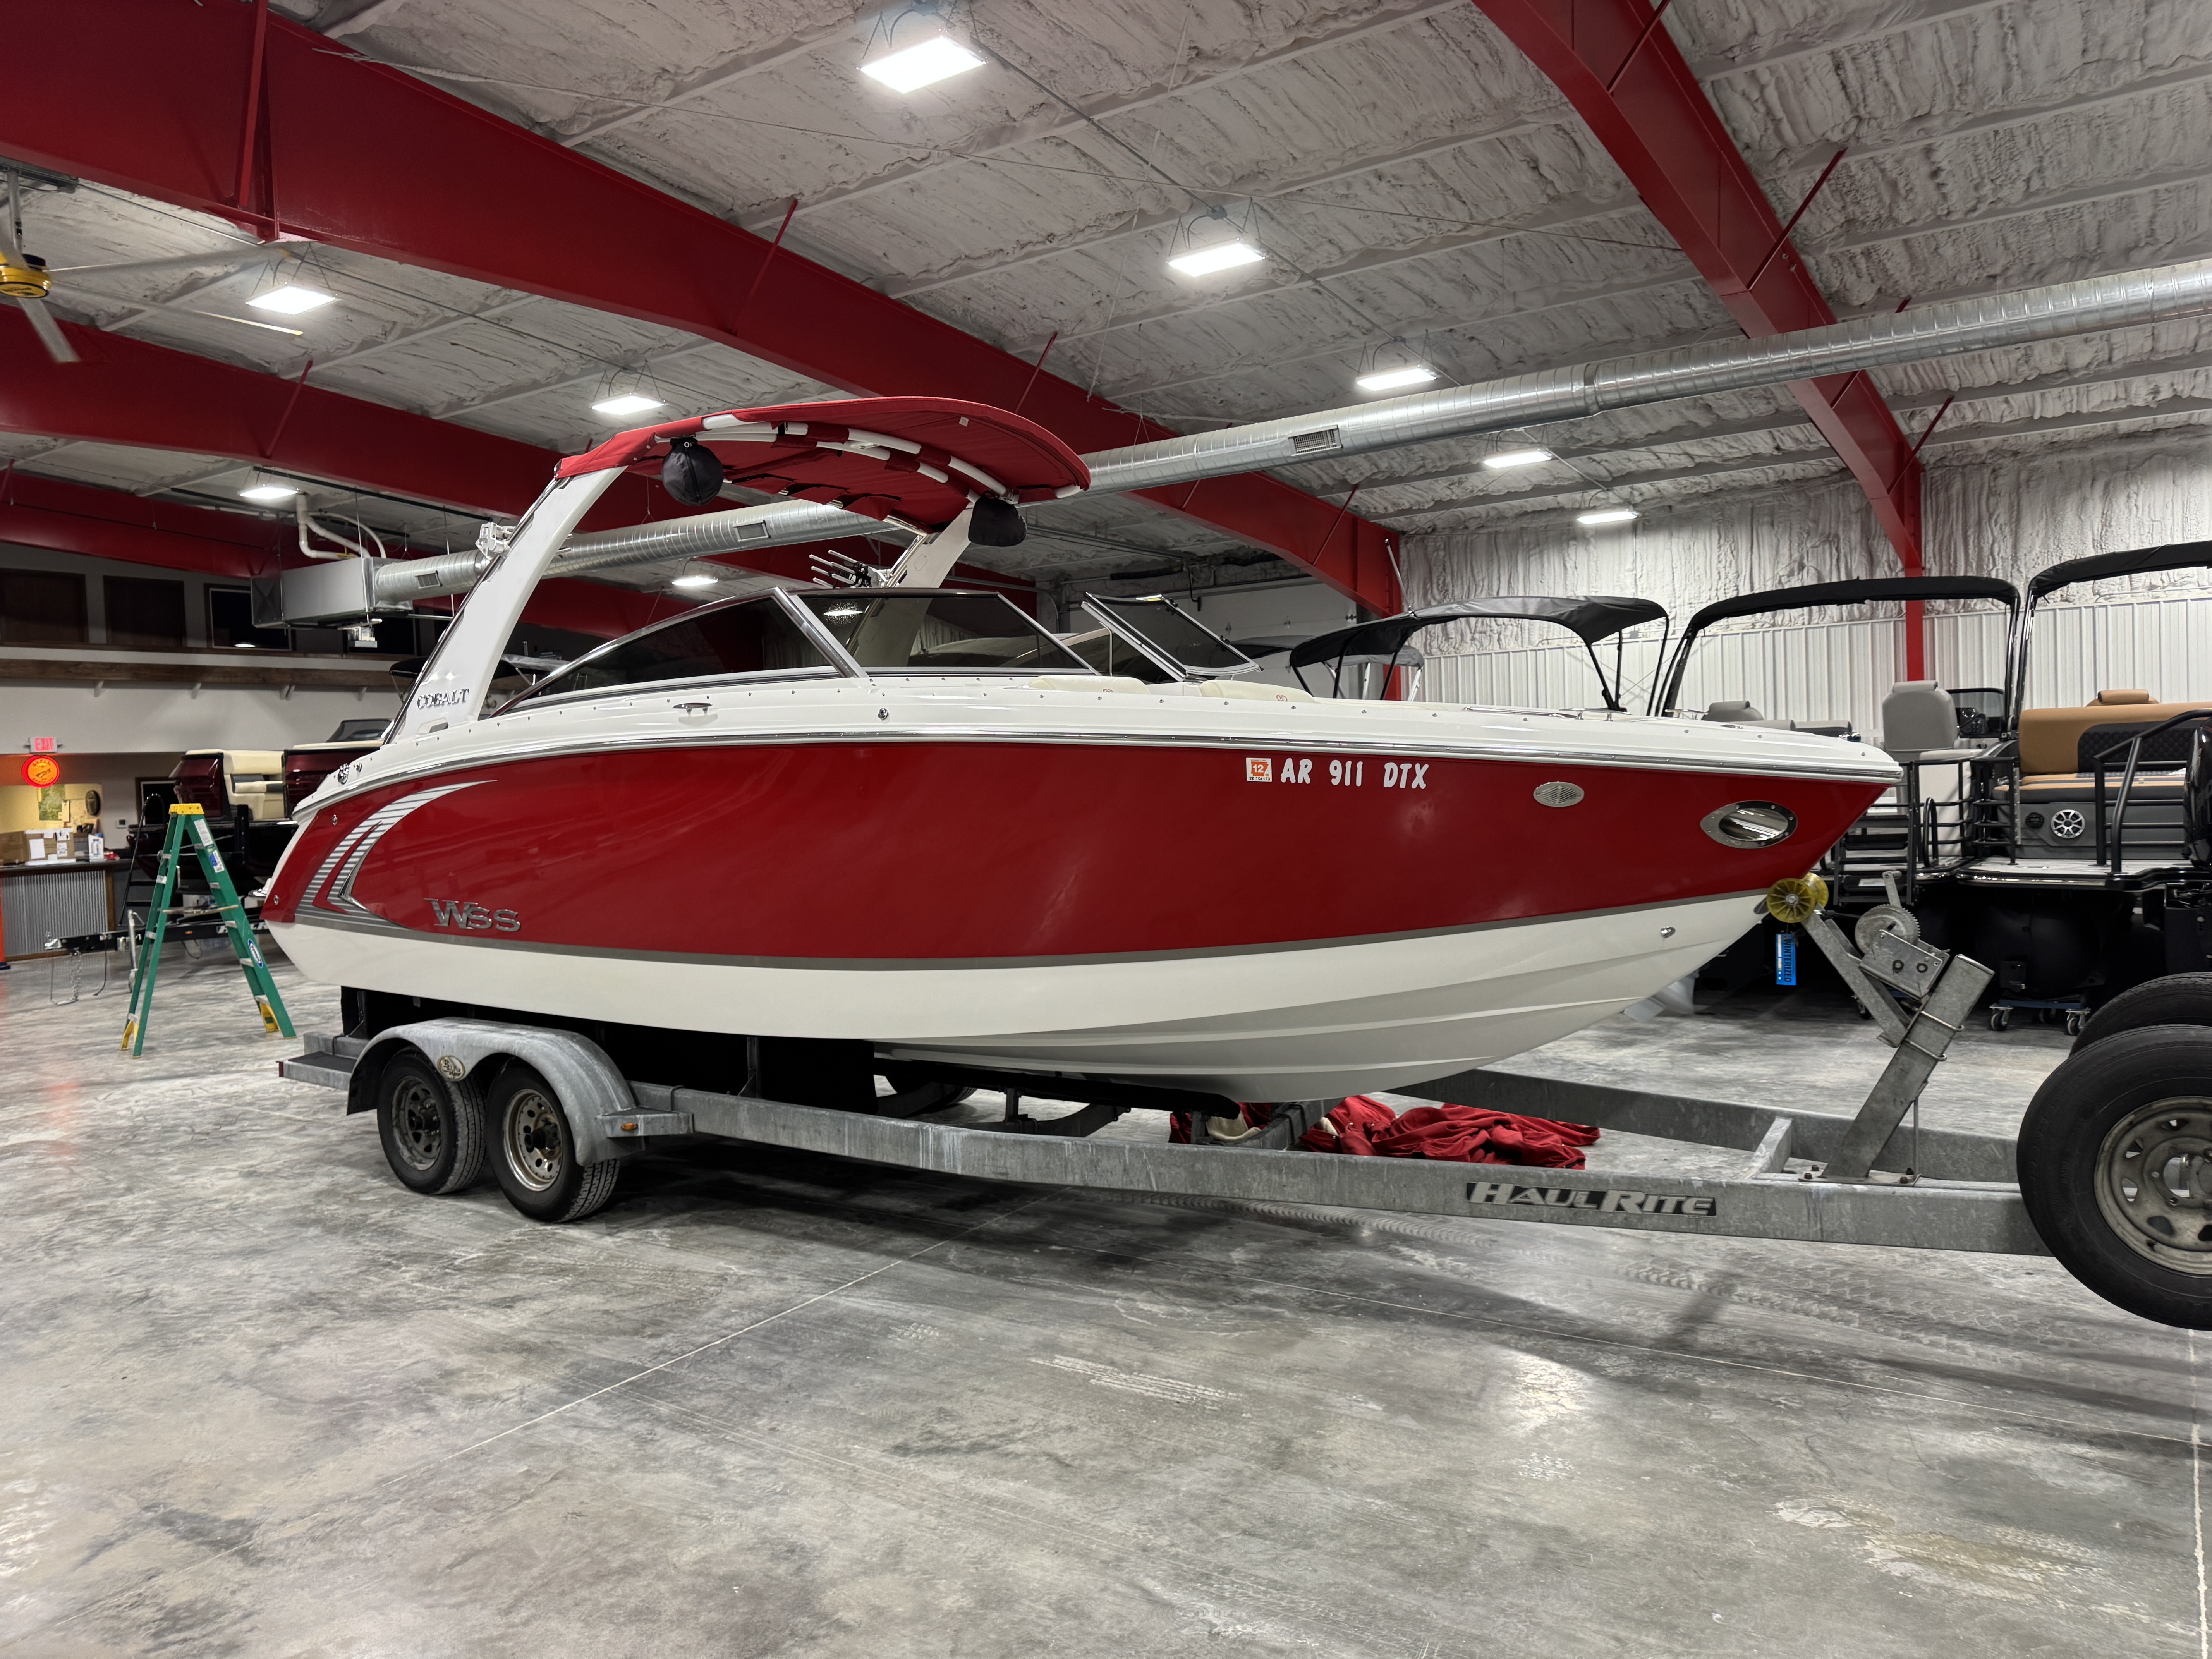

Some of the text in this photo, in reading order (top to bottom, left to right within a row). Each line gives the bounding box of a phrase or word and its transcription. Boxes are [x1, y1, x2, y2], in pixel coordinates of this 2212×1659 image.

[417, 688, 469, 709] COBALT
[35, 737, 53, 751] EXIT
[1253, 764, 1264, 773] 12
[1281, 758, 1429, 790] AR 911 DTX
[424, 898, 520, 933] WSS
[1784, 939, 1792, 982] WINTERIZED
